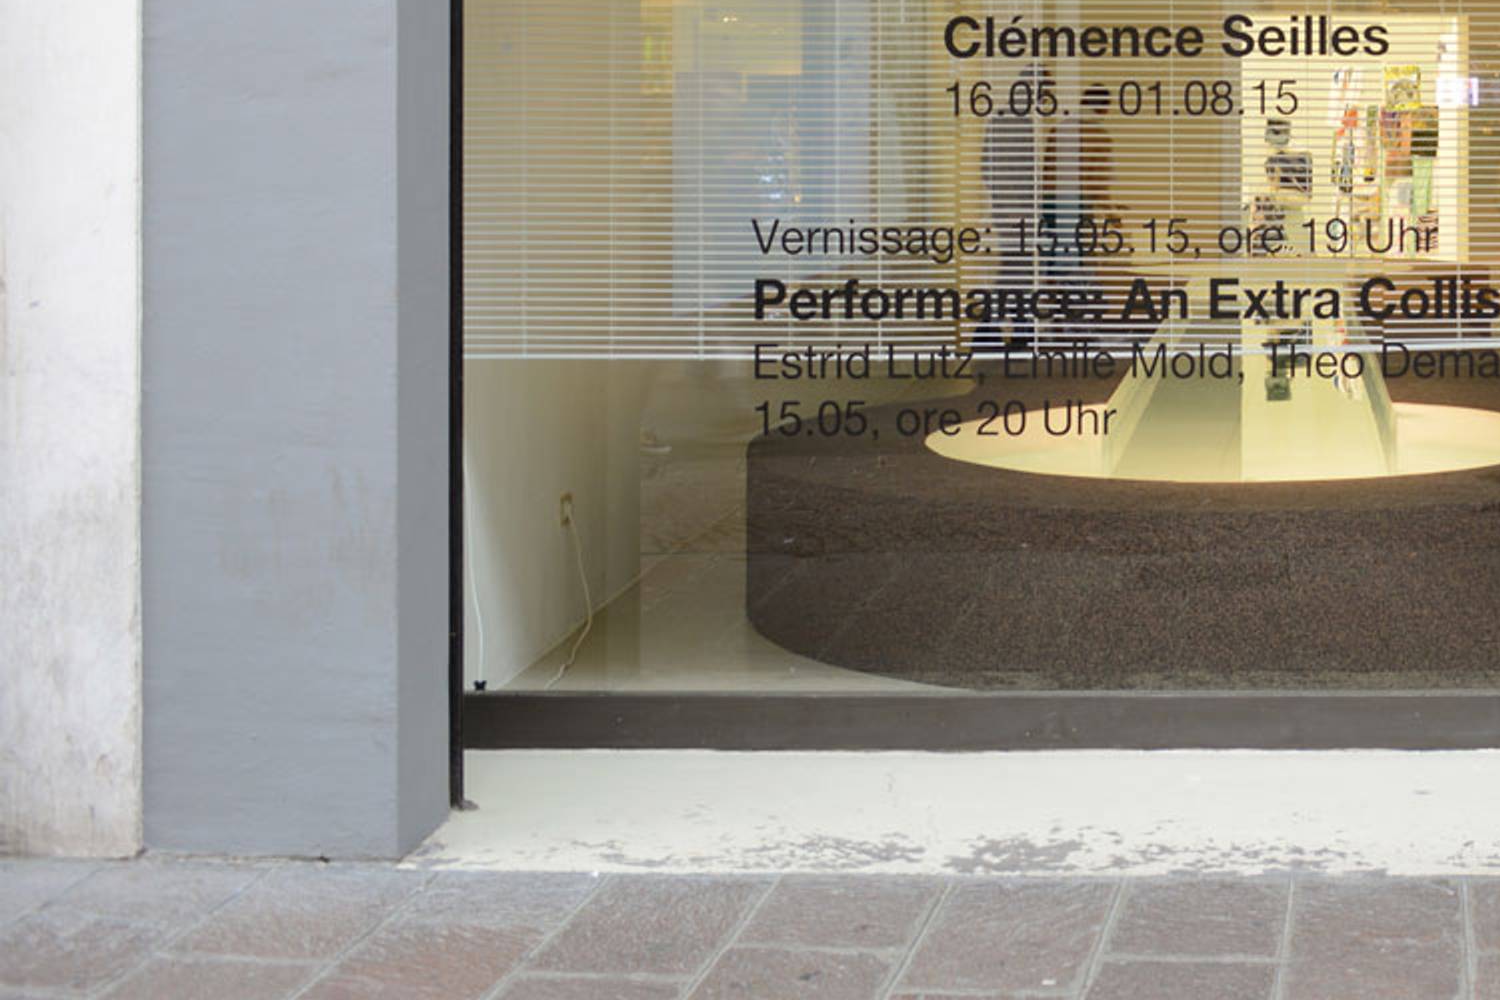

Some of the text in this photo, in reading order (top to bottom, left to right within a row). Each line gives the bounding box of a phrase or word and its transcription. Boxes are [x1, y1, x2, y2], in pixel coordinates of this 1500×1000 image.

[944, 14, 1389, 58] Clémence Seilles
[945, 79, 1070, 117] 16.05.
[1118, 79, 1299, 117] 01.08.15
[752, 217, 1439, 264] Vernissage: 15.05.15, ore 19 Uhr
[754, 278, 1103, 321] Performance:
[1121, 278, 1188, 321] An
[1210, 278, 1341, 321] Extra
[754, 344, 871, 380] Estrid
[888, 344, 986, 386] Lutz,
[1004, 344, 1116, 380] Emile
[1131, 343, 1245, 385] Mold,
[1266, 343, 1365, 380] Theo
[754, 400, 1118, 441] 15.05, ore 20 Uhr
